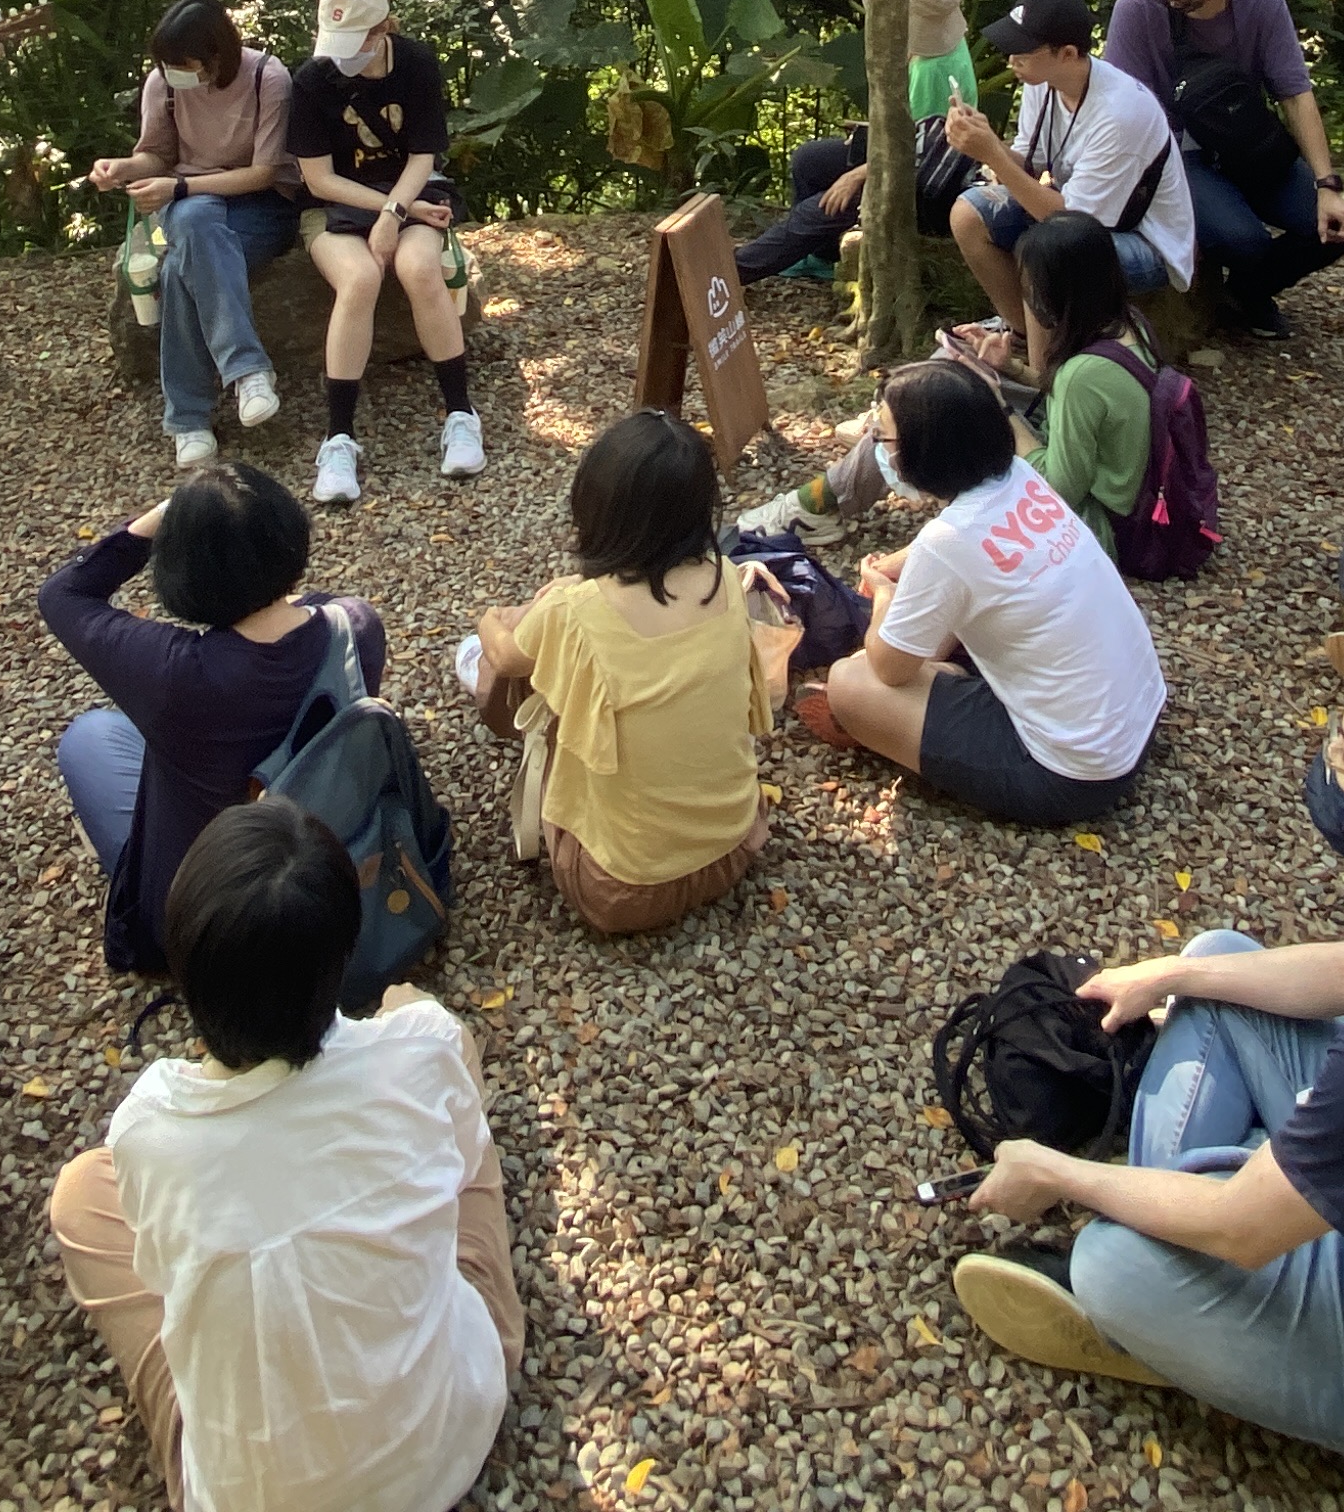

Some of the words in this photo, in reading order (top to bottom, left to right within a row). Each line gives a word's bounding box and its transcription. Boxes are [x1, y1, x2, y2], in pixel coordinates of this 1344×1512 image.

[332, 8, 344, 22] S
[982, 473, 1066, 573] LYGS
[1047, 516, 1081, 566] choir
